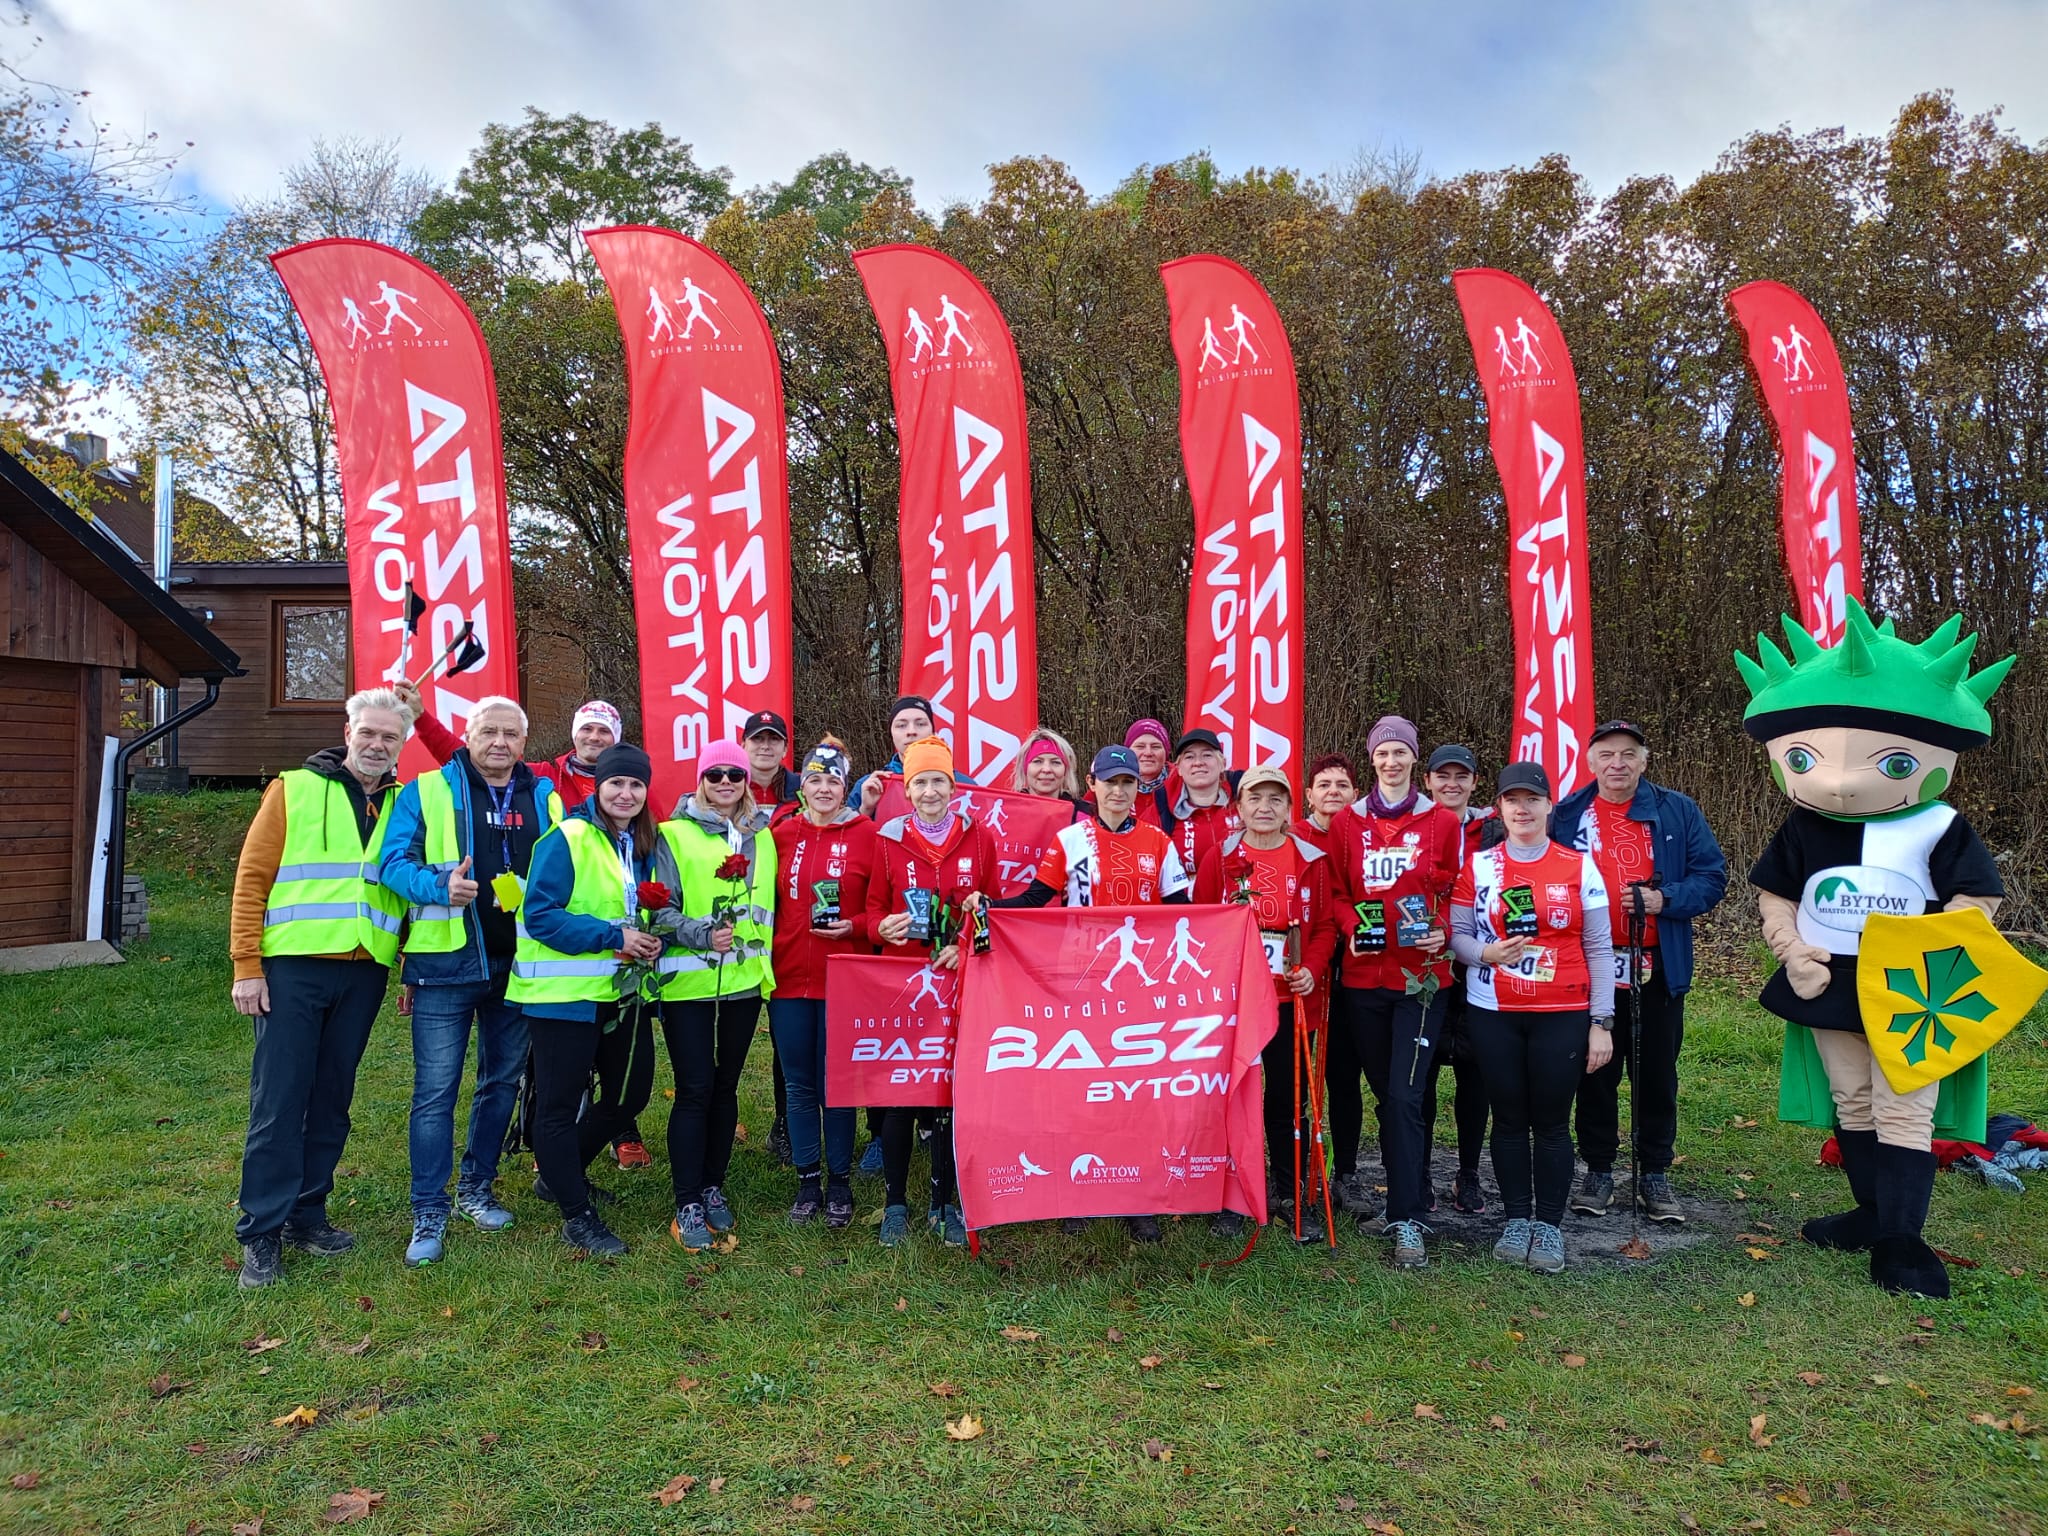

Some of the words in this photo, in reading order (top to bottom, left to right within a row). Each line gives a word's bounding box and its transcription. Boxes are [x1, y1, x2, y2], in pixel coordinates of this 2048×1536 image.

[789, 839, 806, 900] BASZTA
[1370, 857, 1406, 882] 105
[1839, 893, 1909, 910] BYTÓW
[1416, 910, 1424, 920] 3
[1614, 956, 1626, 979] 3
[1024, 998, 1127, 1019] nordic
[1153, 983, 1237, 1010] walki
[854, 1015, 924, 1029] nordic
[851, 1036, 955, 1062] BAS
[985, 1014, 1237, 1073] BASZ
[890, 1067, 955, 1084] BYT
[1086, 1069, 1231, 1103] BYTÓW
[987, 1164, 1017, 1177] POWIAT
[988, 1174, 1027, 1187] BYTOWSKI
[1092, 1164, 1140, 1178] BYTÓW
